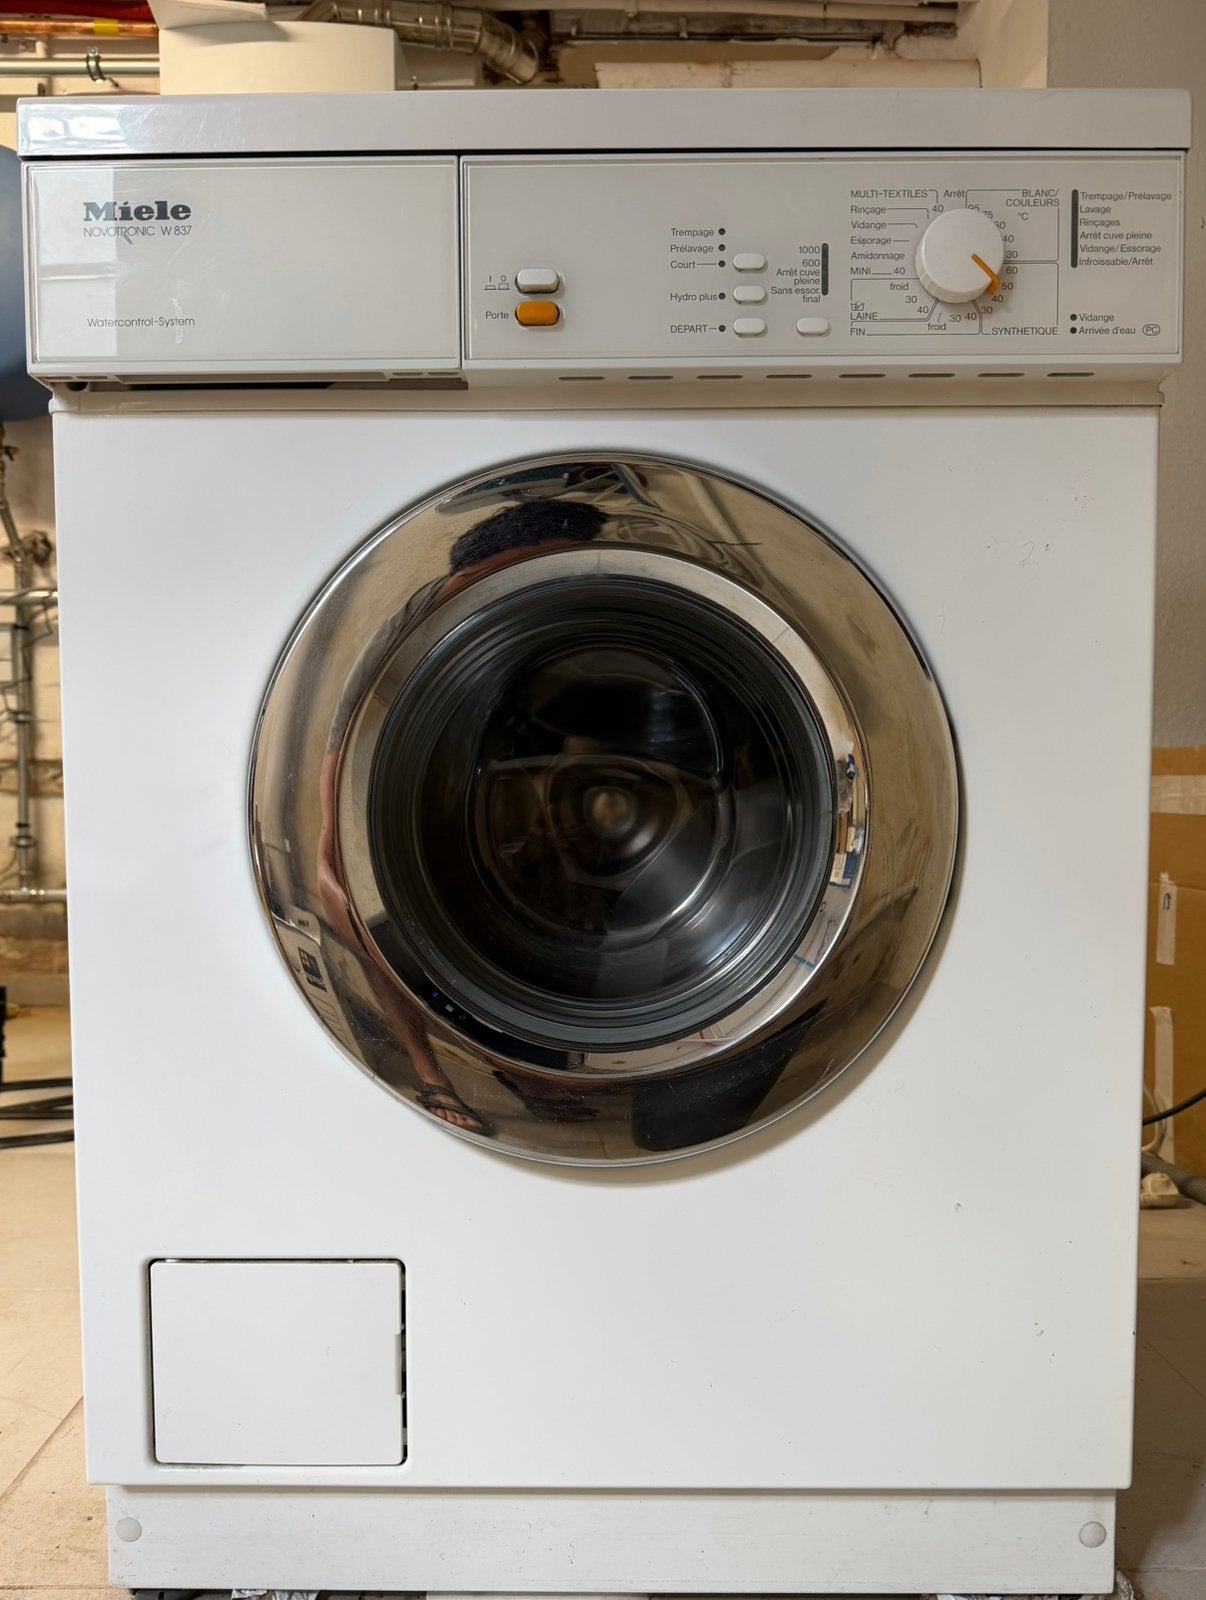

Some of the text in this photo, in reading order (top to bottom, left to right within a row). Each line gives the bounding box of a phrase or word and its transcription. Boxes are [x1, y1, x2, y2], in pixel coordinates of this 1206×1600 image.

[850, 189, 928, 198] MULTI-TEXTILES
[943, 189, 965, 198] Arrêt
[1021, 189, 1060, 198] BLANC/
[1005, 198, 1060, 207] COULEURS
[83, 200, 191, 221] Miele
[850, 205, 887, 215] Rinçage
[932, 205, 944, 213] 40
[1079, 205, 1111, 215] Lavage
[851, 221, 887, 230] Vidange
[1079, 218, 1121, 228] Rinçages
[83, 226, 192, 245] NOVOTRONIC W 837
[670, 228, 715, 239] Trempage
[1002, 234, 1014, 242] 40
[1079, 231, 1102, 240] Arrêt
[1126, 231, 1152, 241] pleine
[850, 236, 892, 245] Essorage
[670, 243, 714, 255] Prélavage
[798, 246, 820, 254] 1000
[1079, 244, 1162, 254] Vidange/Essorage
[850, 252, 905, 261] Amidonnage
[1006, 250, 1018, 258] 30
[670, 260, 696, 269] Court
[802, 258, 820, 267] 600
[1079, 257, 1153, 266] Infroissable/Arrêt
[776, 268, 799, 277] Arrêt
[850, 267, 906, 276] MINI 40
[1006, 266, 1018, 275] 60
[794, 276, 820, 286] pleine
[770, 286, 794, 295] Sans
[890, 282, 910, 291] froid
[1000, 282, 1014, 290] 50
[670, 292, 718, 303] Hydro plus
[802, 294, 821, 304] final
[905, 295, 918, 304] 30
[991, 295, 1004, 303] 40
[917, 306, 929, 314] 40
[980, 306, 993, 314] 30
[485, 310, 510, 320] Porte
[850, 312, 878, 320] LAINE
[949, 314, 962, 322] 30
[964, 312, 978, 320] 40
[1079, 313, 1114, 323] Vidange
[87, 316, 195, 328] Watercontrol-System
[927, 322, 946, 331] froid
[670, 324, 708, 334] DEPART
[850, 328, 866, 336] FIN
[991, 327, 1059, 336] SYNTHETIQUE
[1079, 326, 1136, 335] Arrivée d'eau
